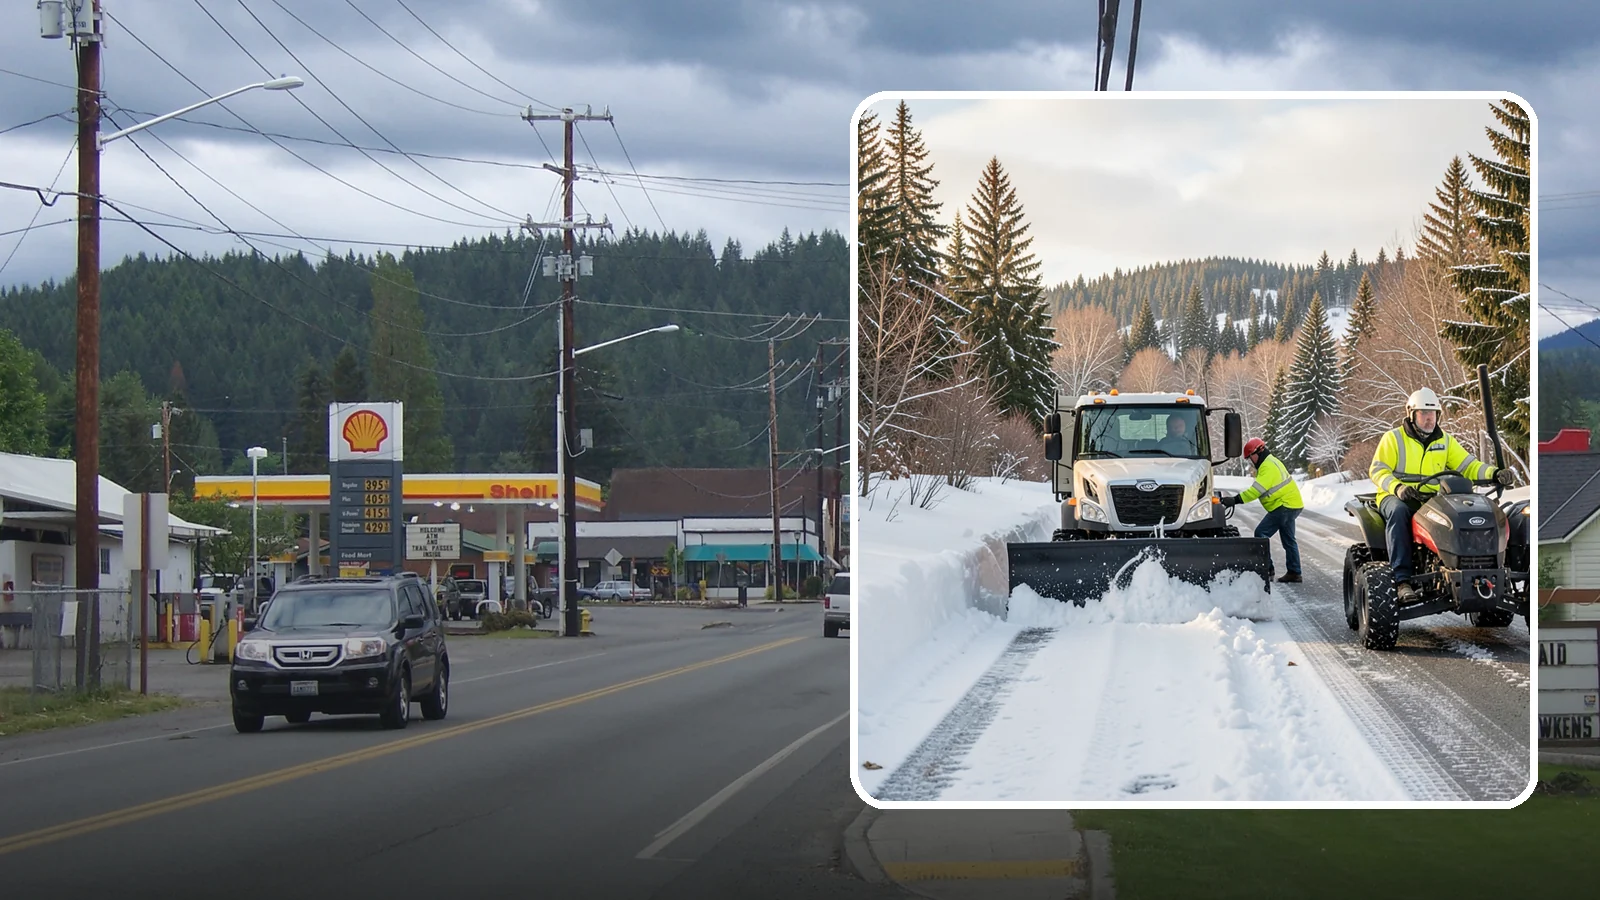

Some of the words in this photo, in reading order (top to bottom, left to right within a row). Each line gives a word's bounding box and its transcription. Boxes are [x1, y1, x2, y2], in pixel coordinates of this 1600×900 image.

[366, 480, 383, 490] 395
[490, 484, 547, 499] Shell
[366, 494, 383, 504] 405
[366, 508, 383, 518] 415
[366, 522, 383, 532] 429
